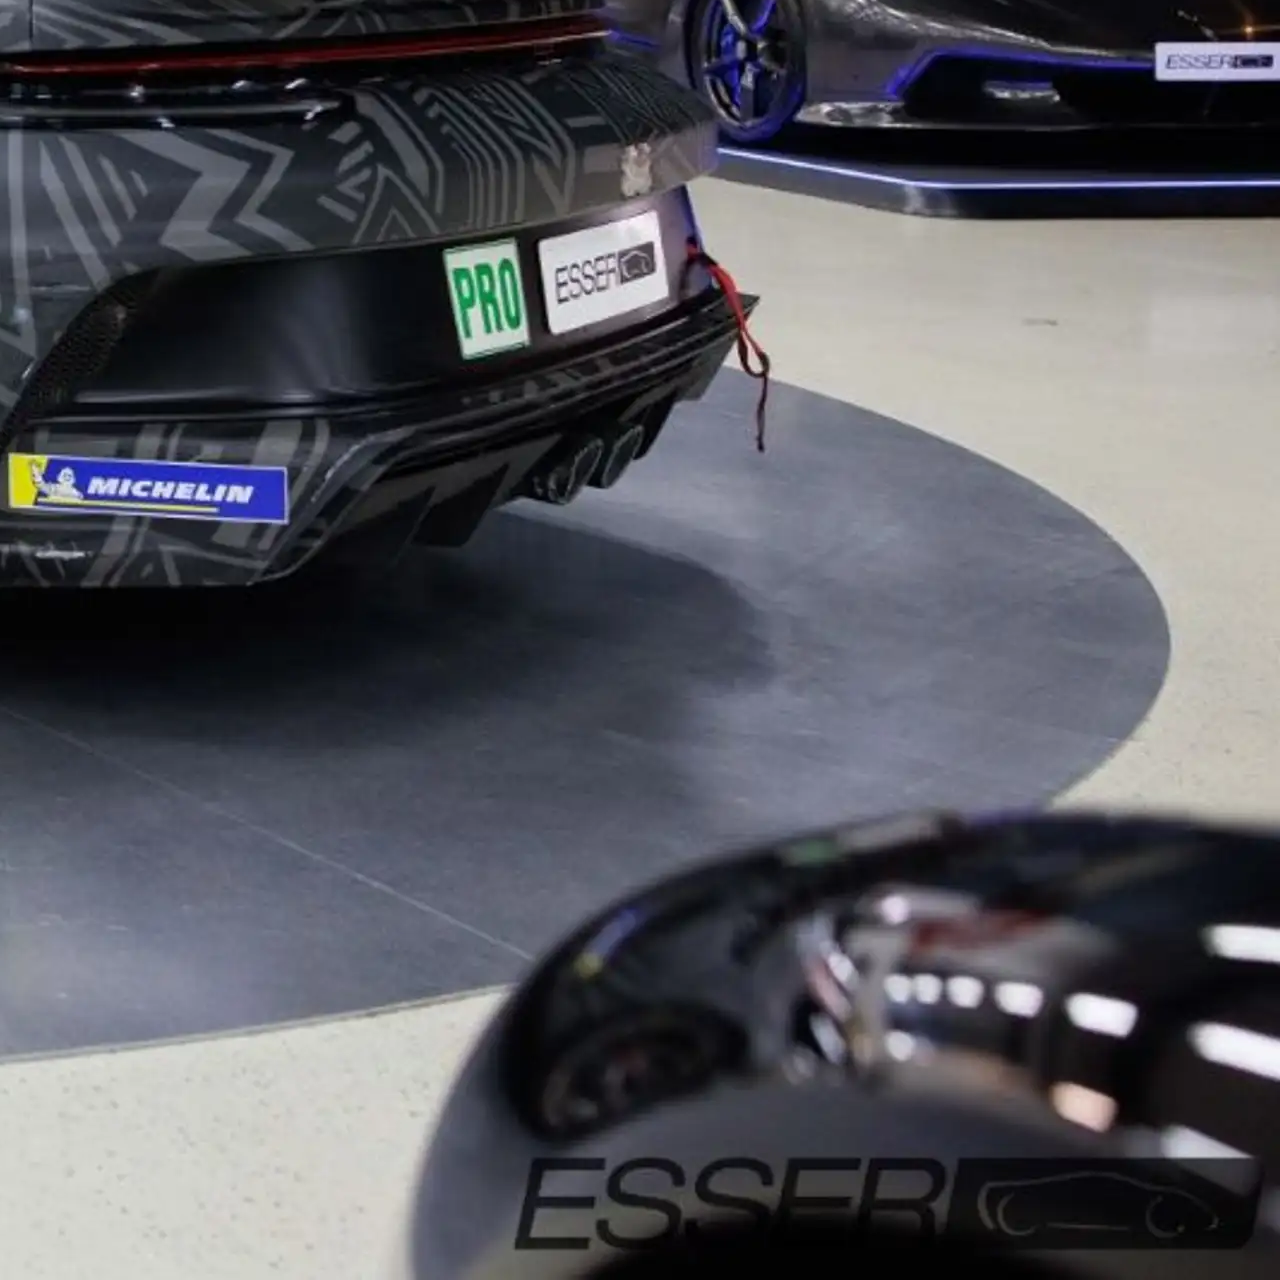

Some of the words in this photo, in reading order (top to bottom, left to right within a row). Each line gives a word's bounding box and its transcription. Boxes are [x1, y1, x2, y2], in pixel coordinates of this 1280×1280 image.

[1166, 54, 1234, 70] ESSER
[554, 252, 619, 304] ESSER
[453, 258, 521, 339] PRO
[87, 476, 254, 504] MICHELIN
